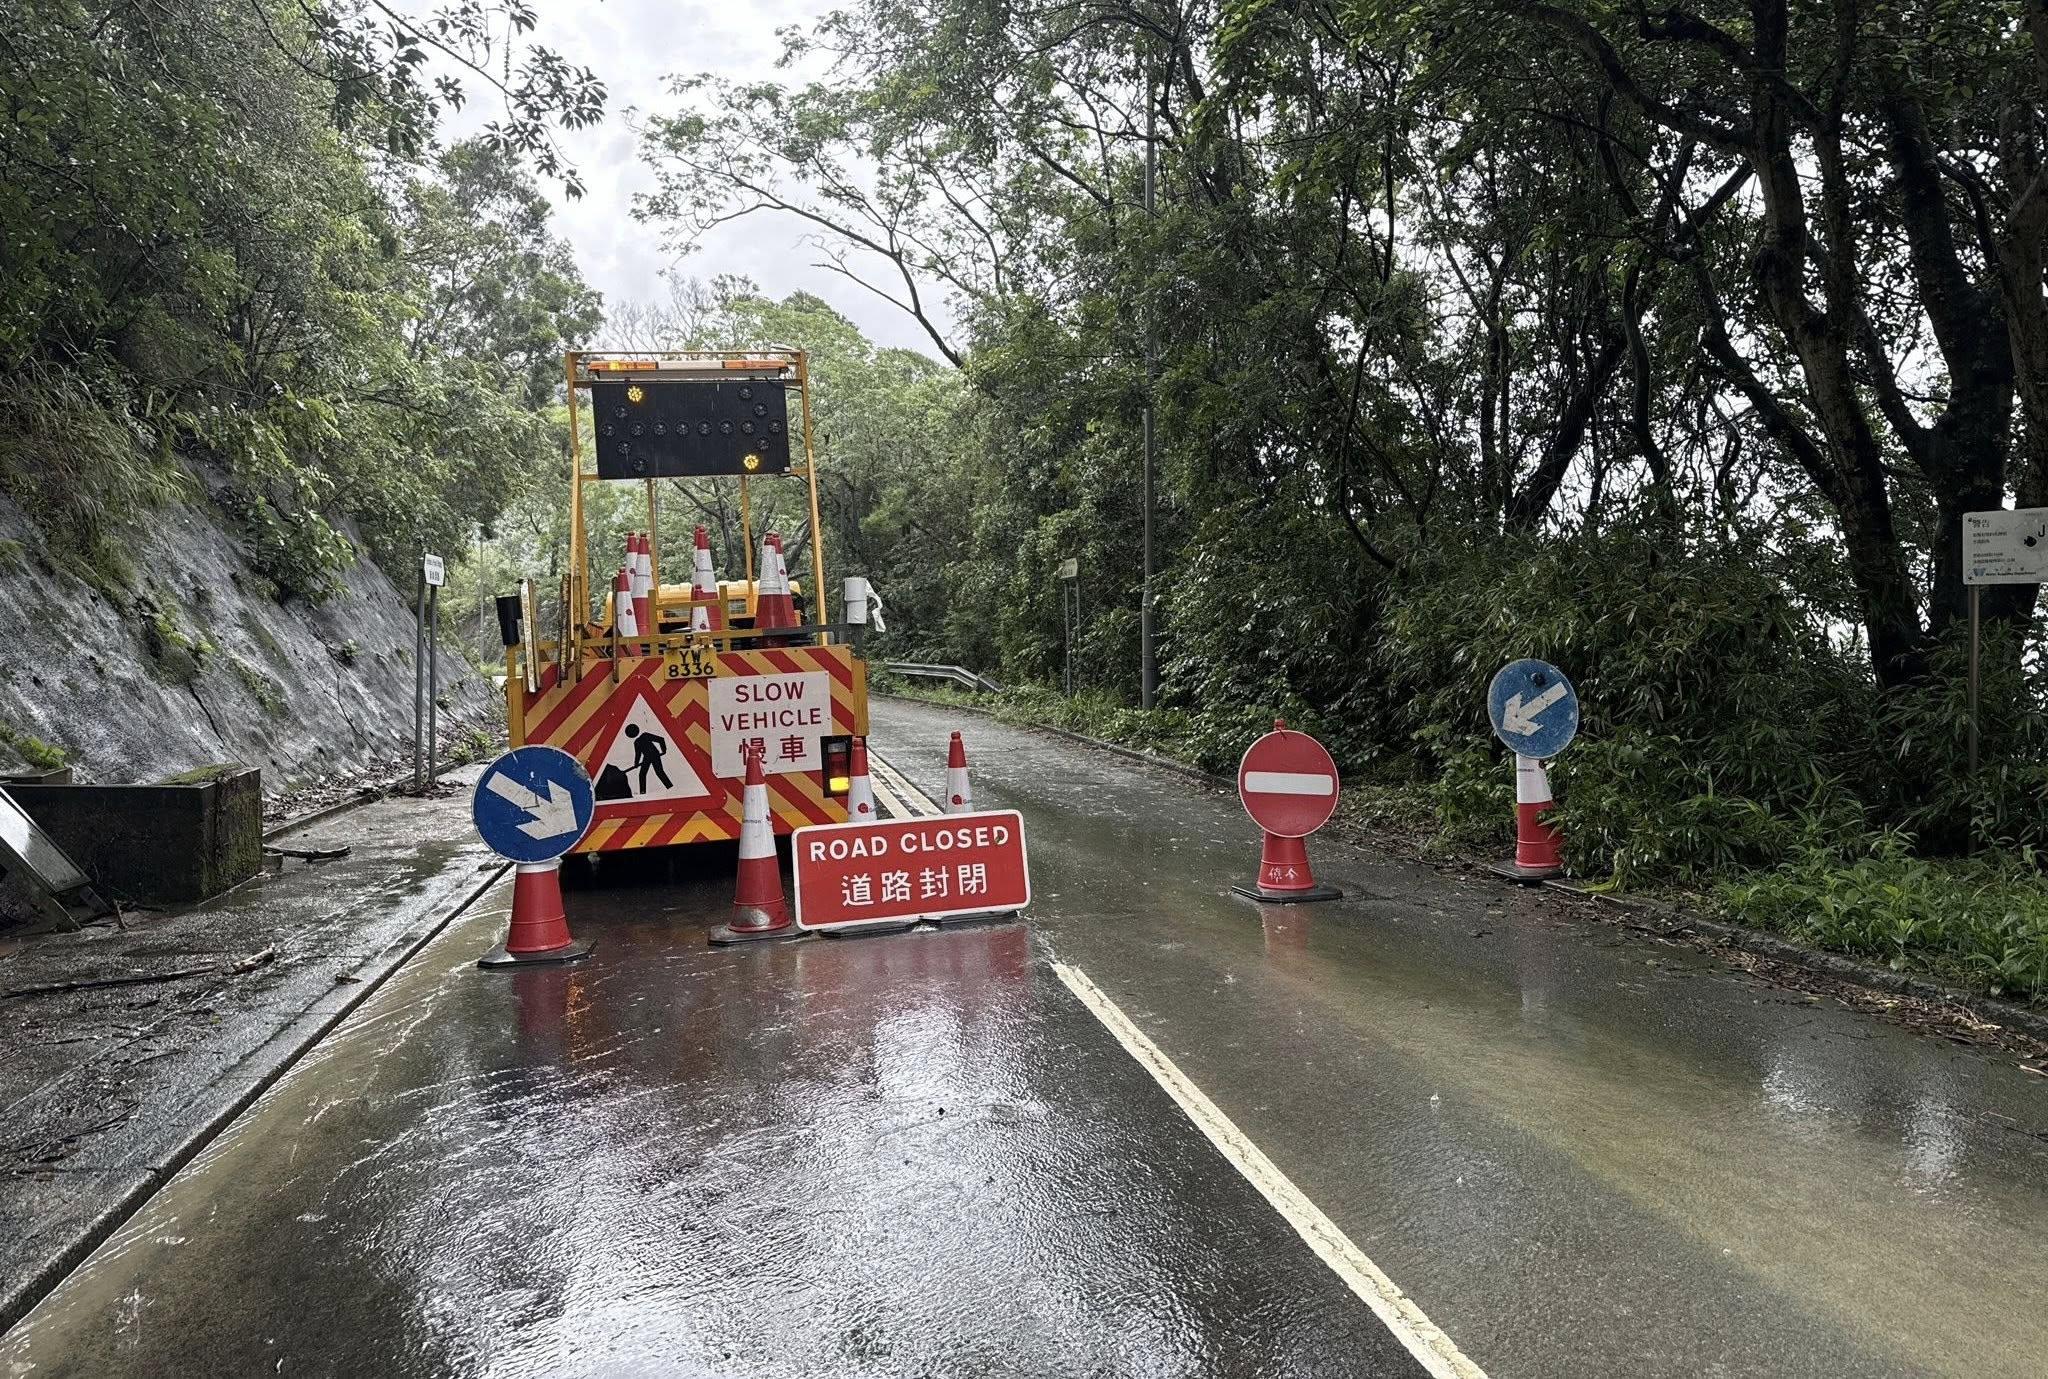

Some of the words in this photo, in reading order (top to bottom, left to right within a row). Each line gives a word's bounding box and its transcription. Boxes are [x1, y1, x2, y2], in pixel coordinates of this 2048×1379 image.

[668, 662, 714, 677] 8336
[735, 681, 804, 703] SLOW
[721, 707, 822, 731] VEHICLE
[810, 836, 888, 862] ROAD
[900, 825, 1009, 854] CLOSED
[841, 863, 988, 907] 道路封閉
